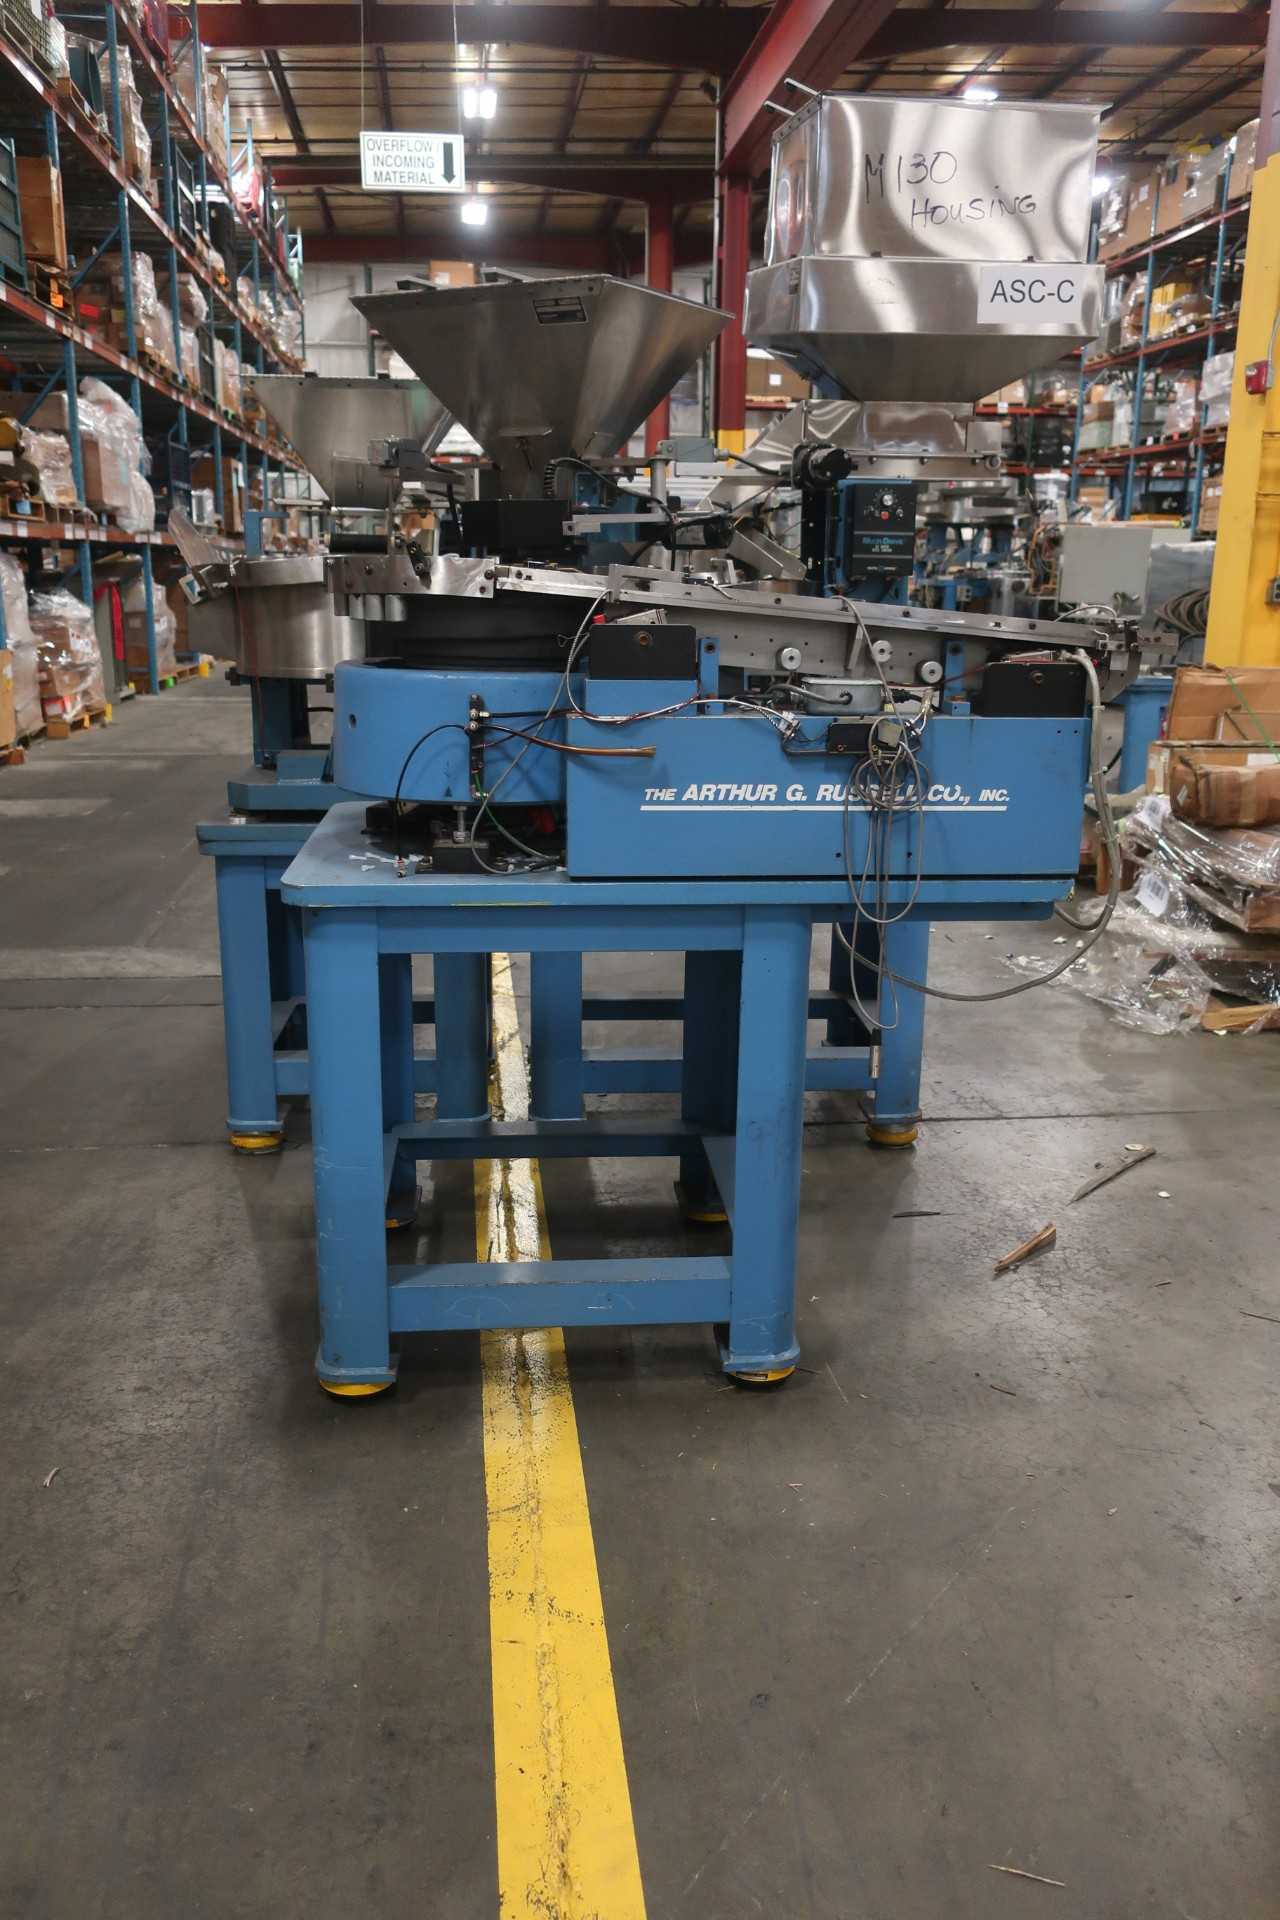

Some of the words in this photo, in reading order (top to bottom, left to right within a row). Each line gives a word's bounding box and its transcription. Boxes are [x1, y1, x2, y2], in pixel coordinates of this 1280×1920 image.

[366, 138, 433, 152] OVERFLOW
[372, 154, 435, 169] INCOMING
[373, 170, 436, 185] MATERIAL
[990, 279, 1075, 304] ASC-C
[644, 788, 678, 801] THE
[681, 784, 778, 801] ARTHUR
[785, 783, 808, 802] G.
[978, 789, 1011, 802] INC.
